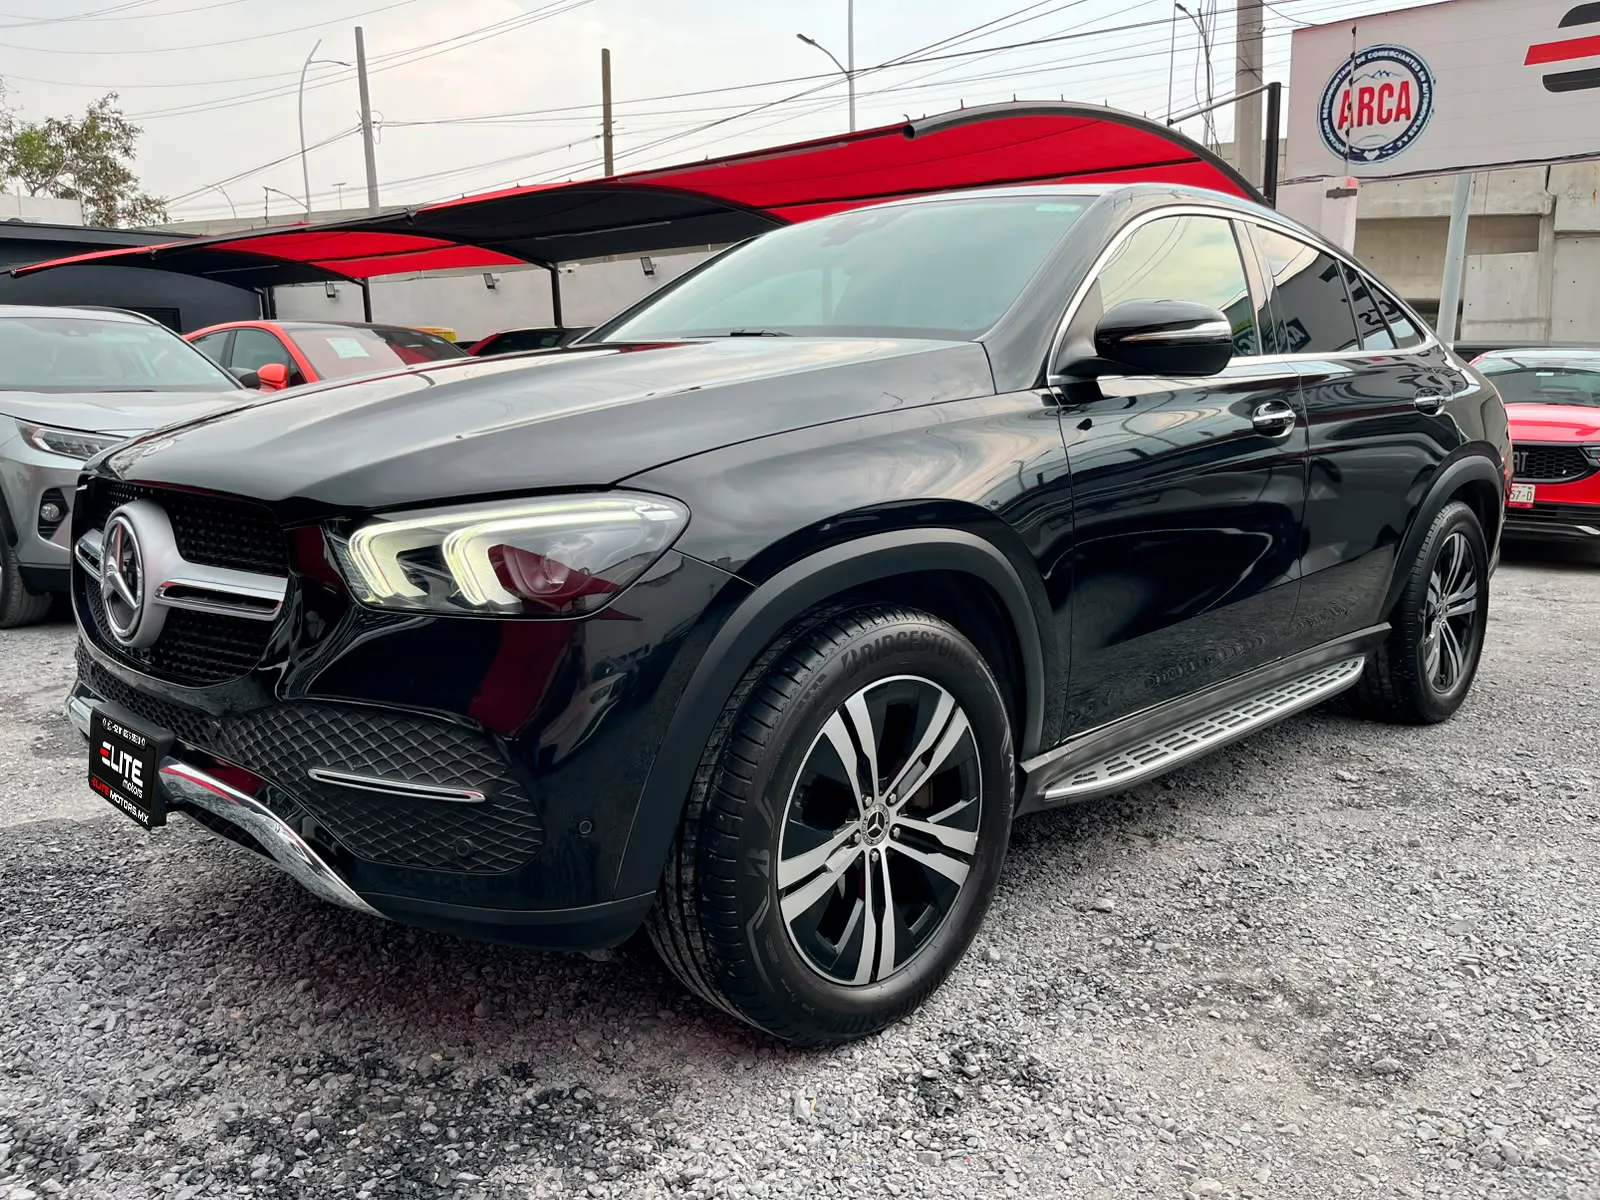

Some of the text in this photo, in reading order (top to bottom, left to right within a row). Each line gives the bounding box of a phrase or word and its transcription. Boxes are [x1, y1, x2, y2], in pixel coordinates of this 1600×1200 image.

[1367, 50, 1420, 72] COMERCIANTES
[1337, 81, 1411, 130] ARCA
[841, 630, 972, 677] BRIDGESTONE
[99, 741, 143, 788] ELITE
[122, 779, 143, 799] motors
